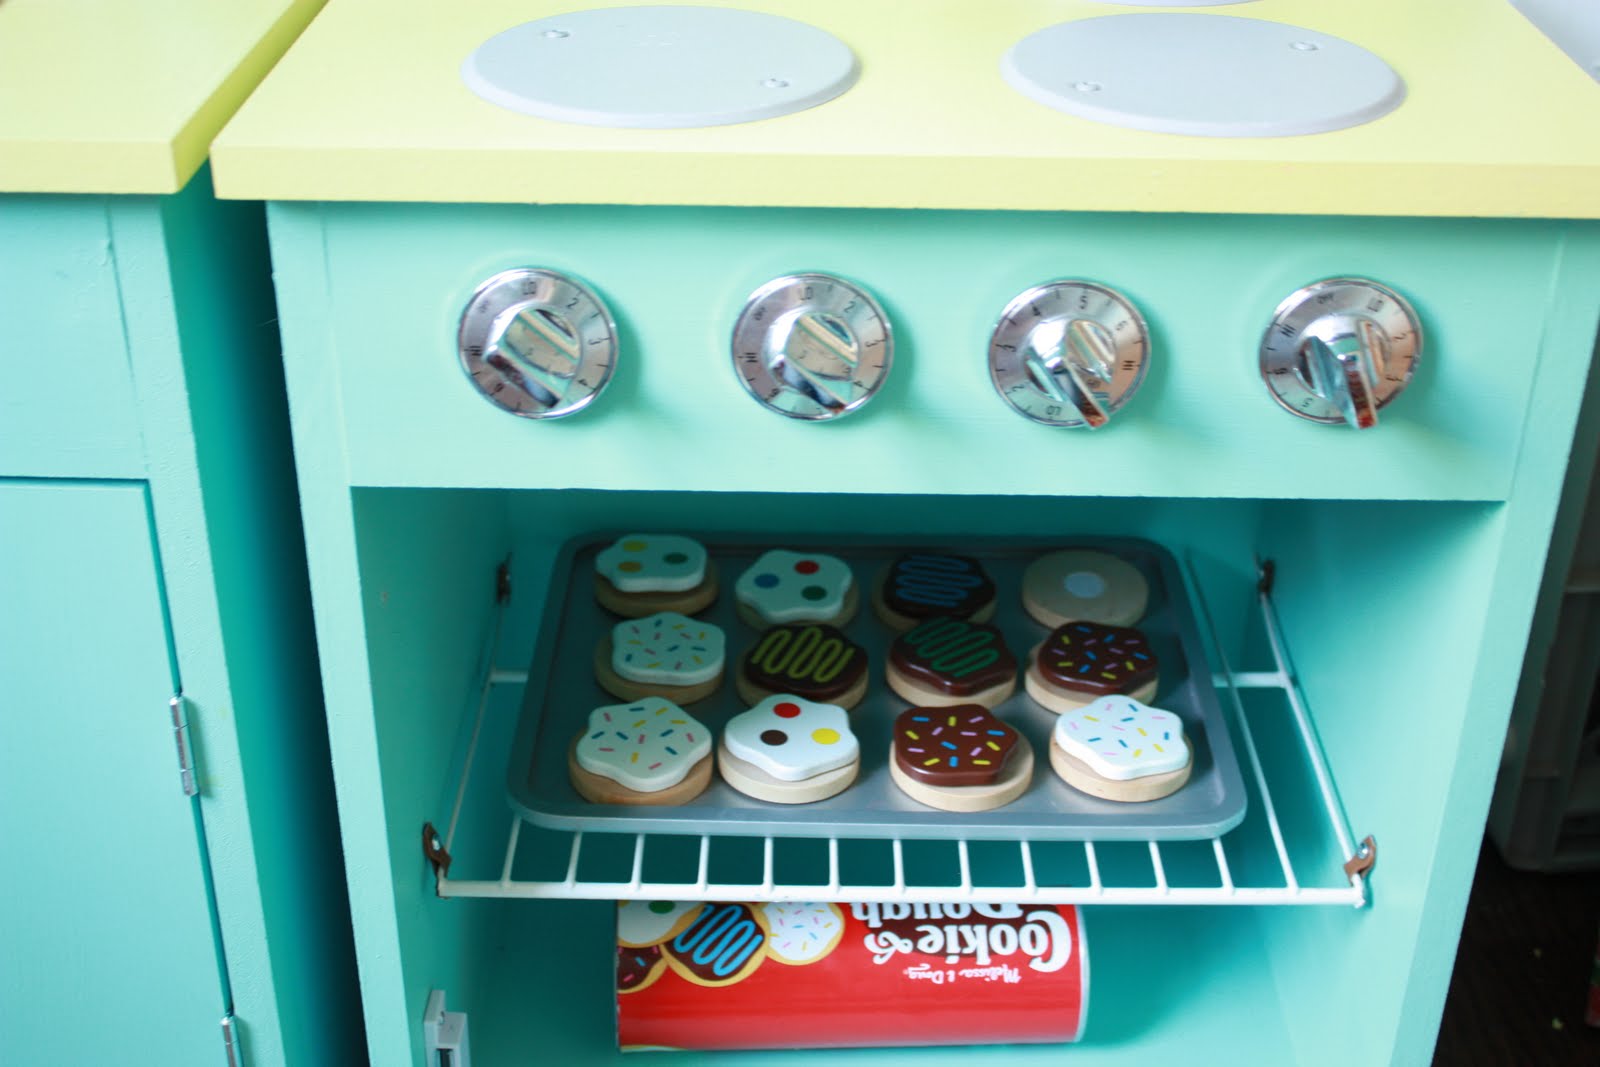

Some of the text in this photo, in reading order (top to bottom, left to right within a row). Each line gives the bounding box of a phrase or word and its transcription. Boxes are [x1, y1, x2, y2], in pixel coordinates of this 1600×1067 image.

[566, 298, 579, 310] 2
[844, 301, 856, 313] 2
[1080, 295, 1088, 309] 5
[863, 910, 1072, 973] Cookie &
[908, 963, 944, 985] Doug
[958, 964, 1021, 984] Melissa
